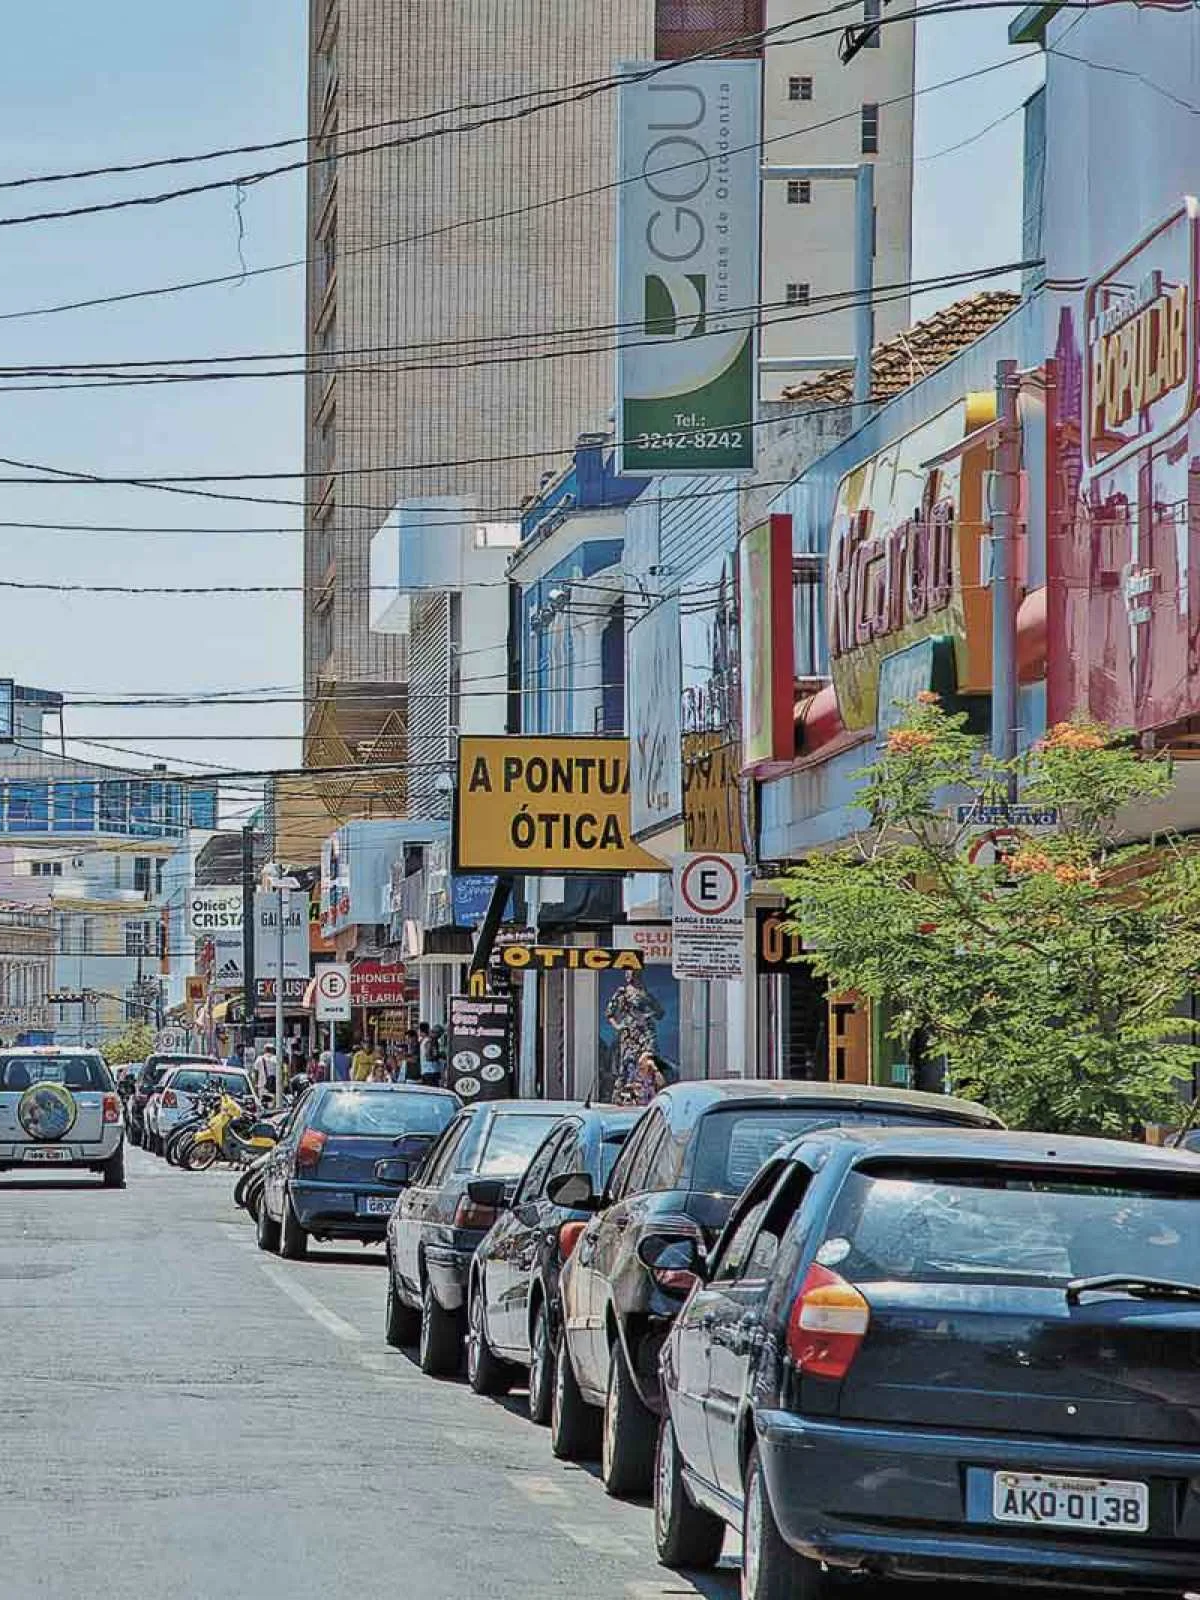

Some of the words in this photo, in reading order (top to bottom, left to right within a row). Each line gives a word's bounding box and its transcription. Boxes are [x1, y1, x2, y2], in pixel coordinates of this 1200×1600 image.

[1090, 286, 1187, 438] POPULAR
[638, 431, 743, 449] 3242-8242
[468, 755, 493, 793] A
[511, 803, 625, 850] ÓTICA
[700, 870, 718, 900] E
[261, 911, 302, 928] GALRIA
[634, 931, 672, 943] CLU
[328, 978, 337, 992] E
